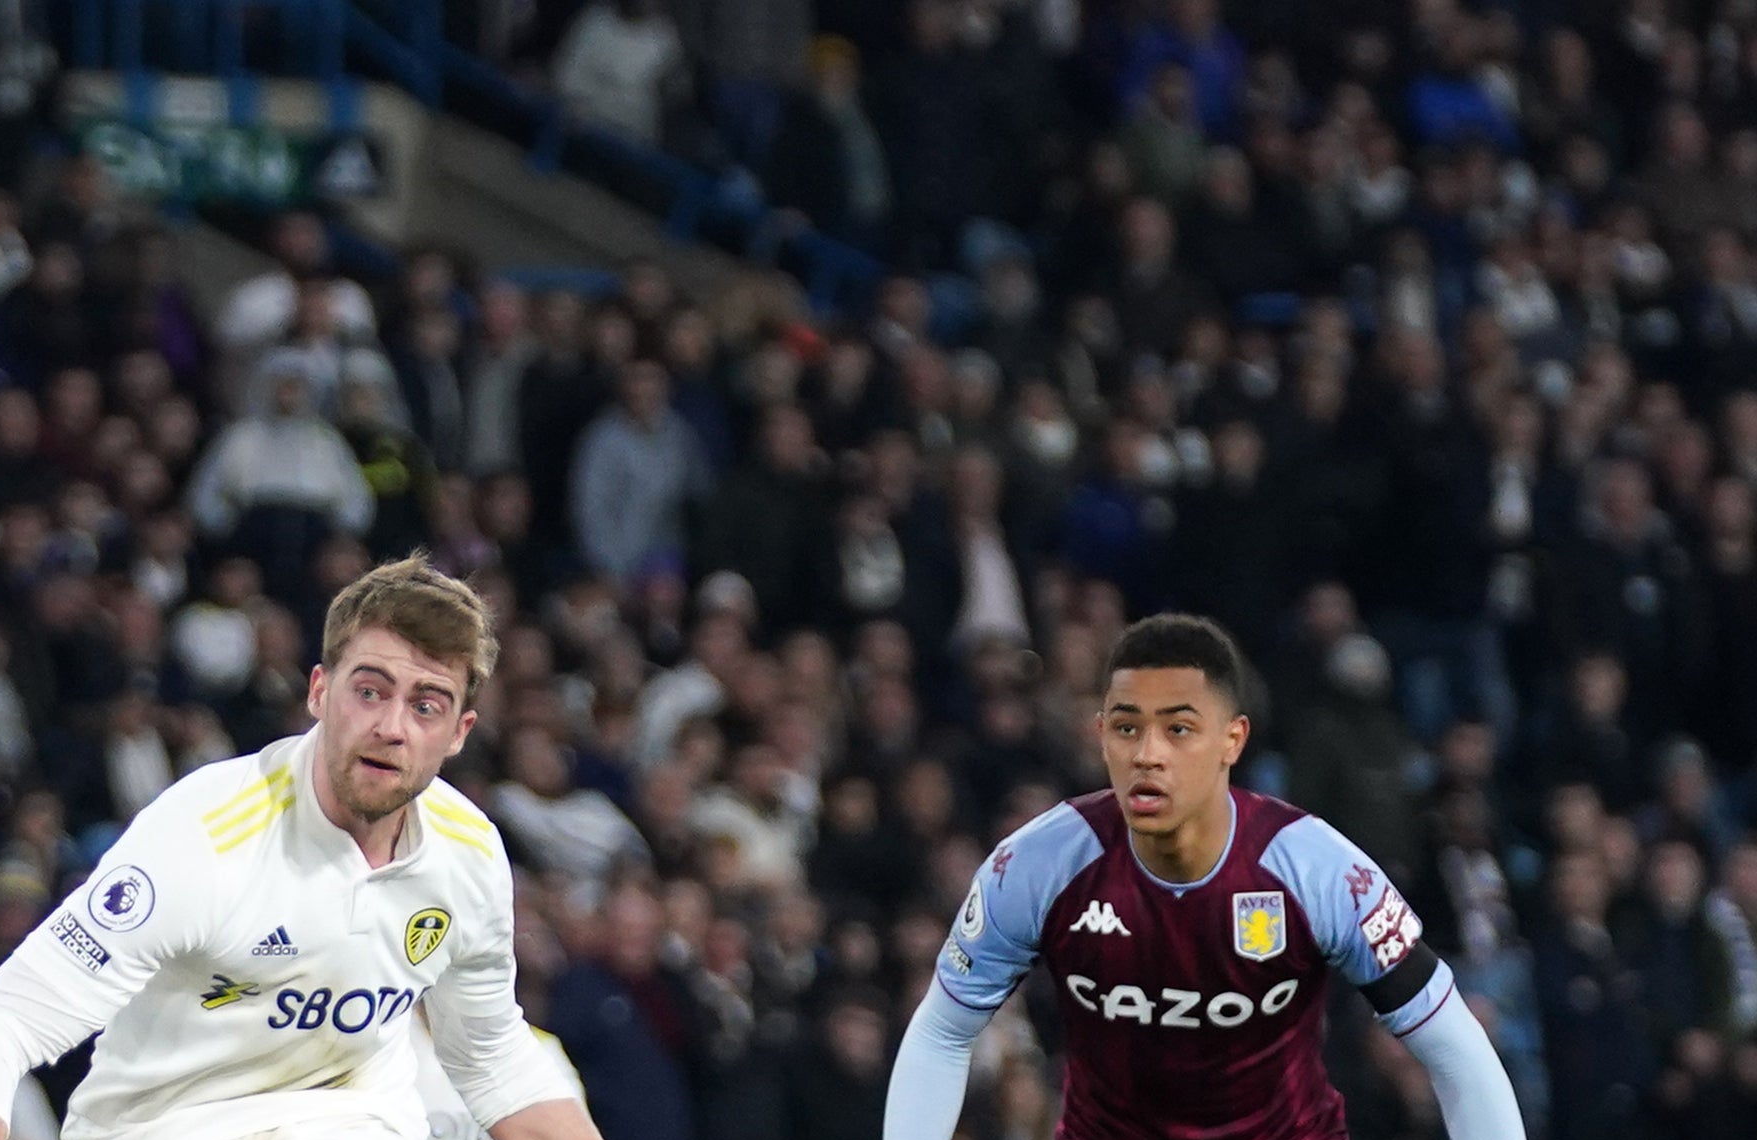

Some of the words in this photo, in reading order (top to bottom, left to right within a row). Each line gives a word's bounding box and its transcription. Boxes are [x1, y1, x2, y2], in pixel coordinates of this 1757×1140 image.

[1238, 895, 1280, 909] AVFC
[60, 910, 77, 931] No
[72, 925, 105, 961] room
[63, 933, 103, 974] racism
[251, 944, 299, 957] adidas
[268, 985, 430, 1034] SBOTO
[1066, 973, 1299, 1028] CAZOO
